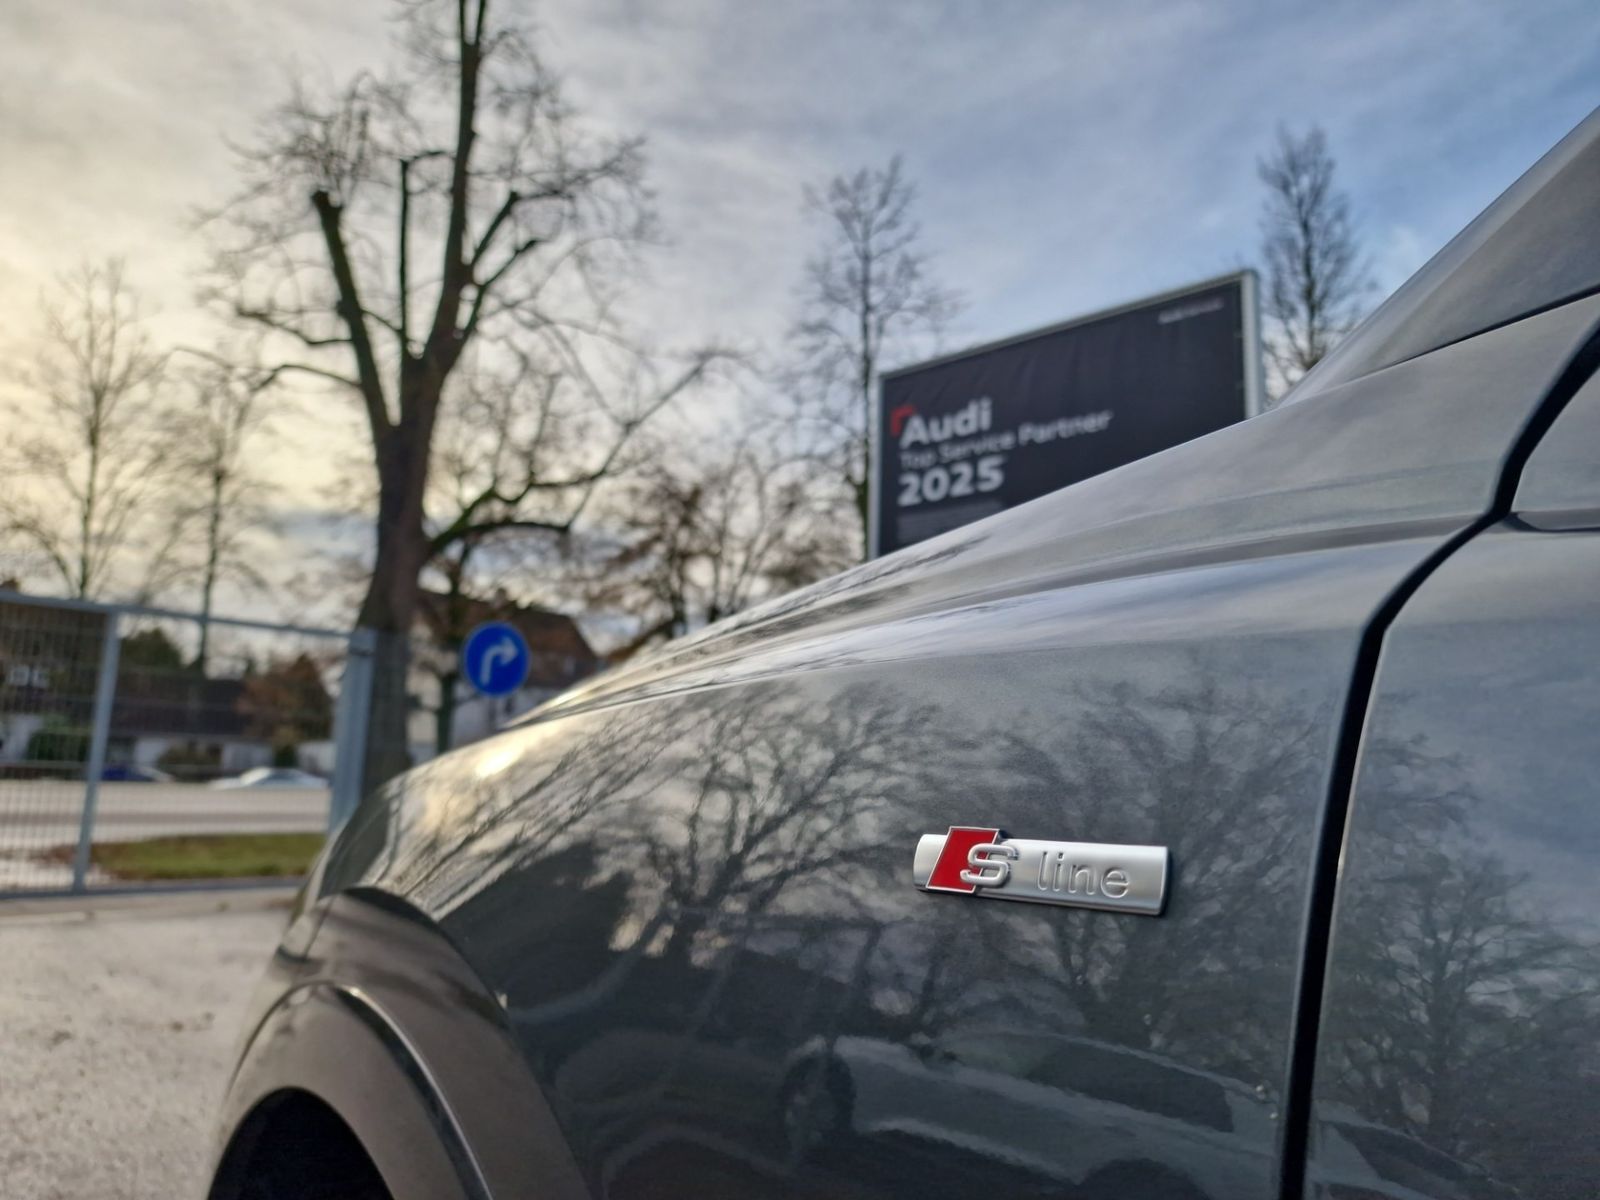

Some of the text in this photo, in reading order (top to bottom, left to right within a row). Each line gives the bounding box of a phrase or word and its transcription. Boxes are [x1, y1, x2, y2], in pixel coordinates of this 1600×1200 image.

[899, 397, 993, 449] Audi
[938, 430, 1016, 461] Service
[1018, 409, 1113, 445] Partner
[897, 453, 1006, 507] 2025
[960, 842, 1130, 899] S line
